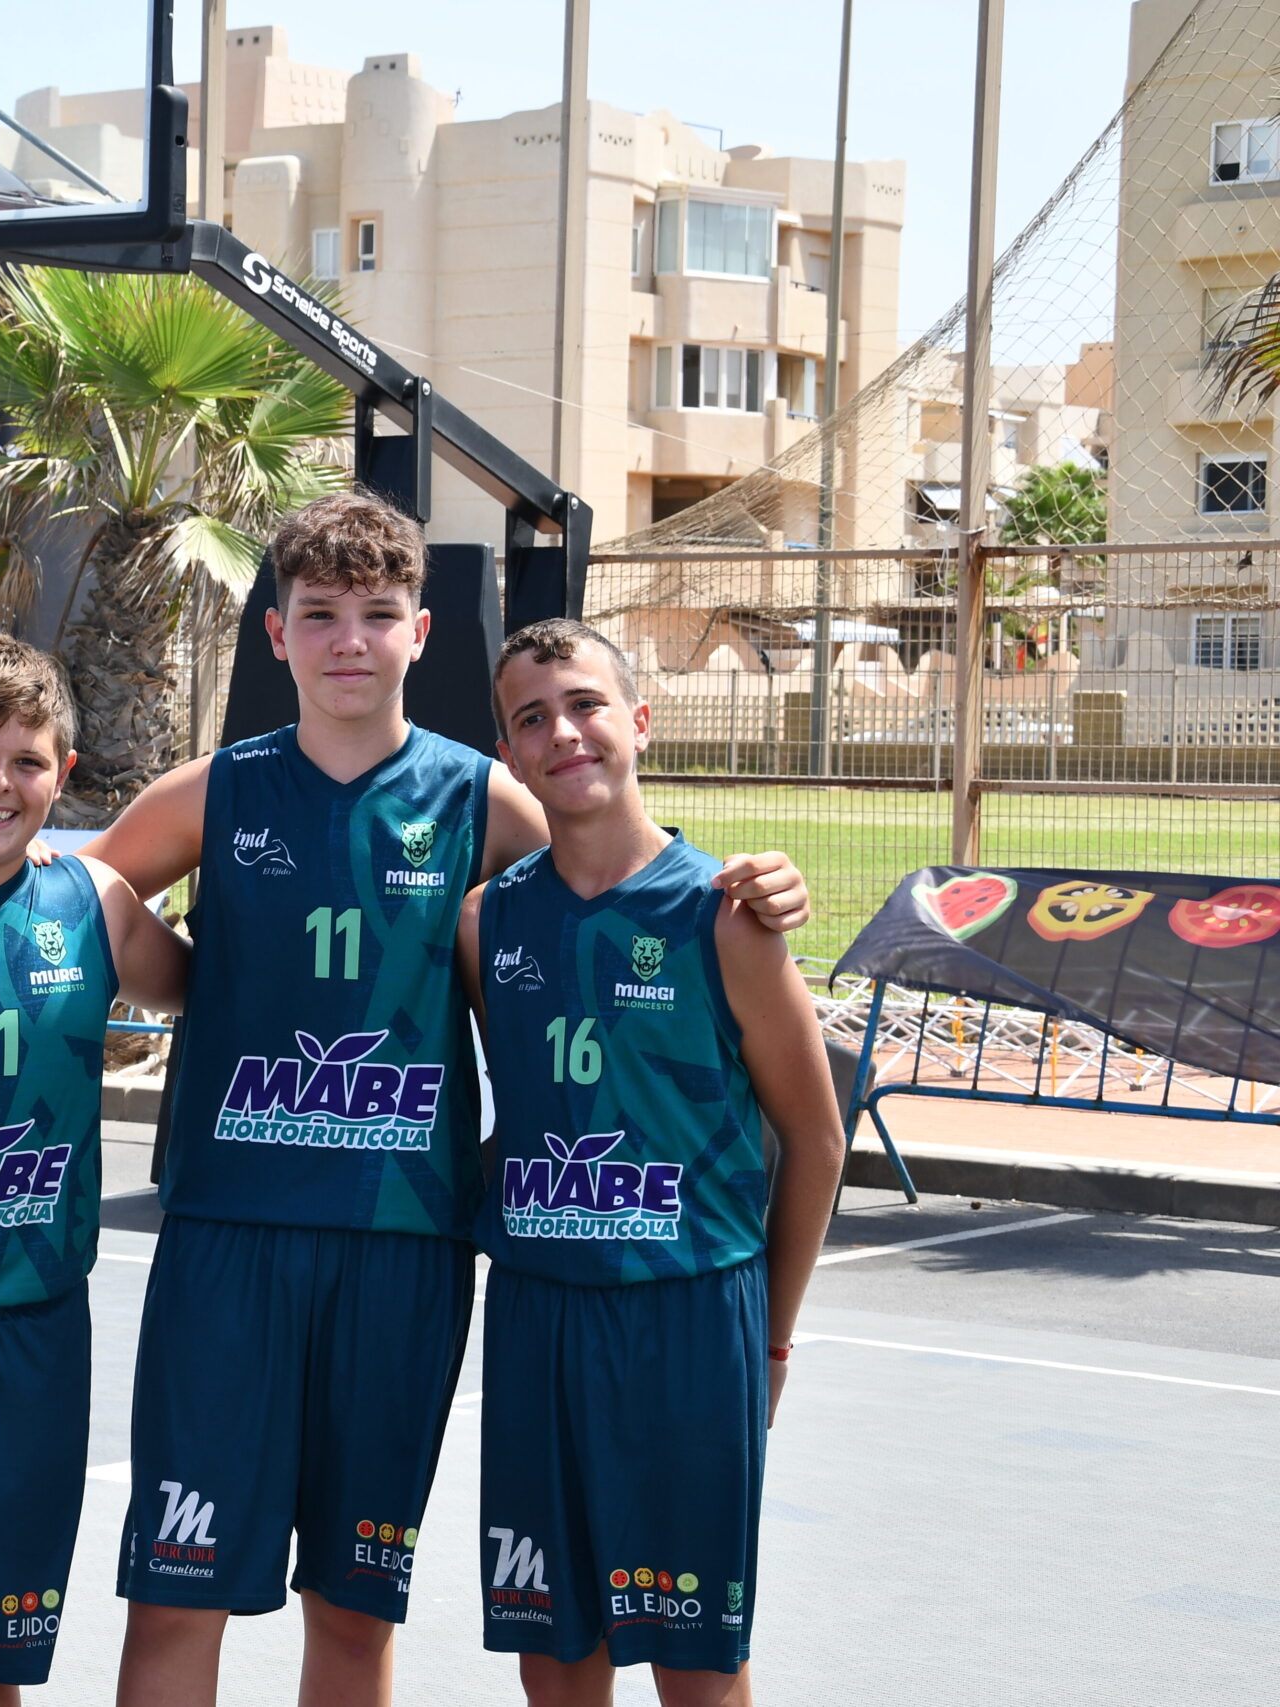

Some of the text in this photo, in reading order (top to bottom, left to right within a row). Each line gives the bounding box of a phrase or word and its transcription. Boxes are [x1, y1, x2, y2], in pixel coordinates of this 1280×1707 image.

[272, 275, 377, 368] Schelde Sports
[232, 748, 270, 761] luanvi
[233, 828, 269, 848] imd
[271, 867, 292, 876] Ejido
[385, 870, 445, 886] MURGI
[385, 886, 445, 897] BALONCESTO
[306, 906, 362, 980] 11
[494, 946, 523, 967] imd
[30, 966, 83, 986] MURGI
[31, 983, 85, 995] BALONCESTO
[614, 983, 675, 1001] MURGI
[614, 1000, 675, 1011] BALONCESTO
[546, 1016, 602, 1085] 16
[224, 1056, 445, 1123] MABE
[214, 1118, 431, 1151] HORTOFRUTICOLA
[503, 1158, 683, 1215] MABE
[152, 1542, 216, 1562] MERCADER
[355, 1543, 376, 1565] EL
[149, 1558, 214, 1577] Consultores
[611, 1592, 702, 1618] EL EJIDO
[7, 1614, 60, 1639] EJIDO
[663, 1622, 703, 1630] QUALITY
[25, 1638, 57, 1648] QUALIT
